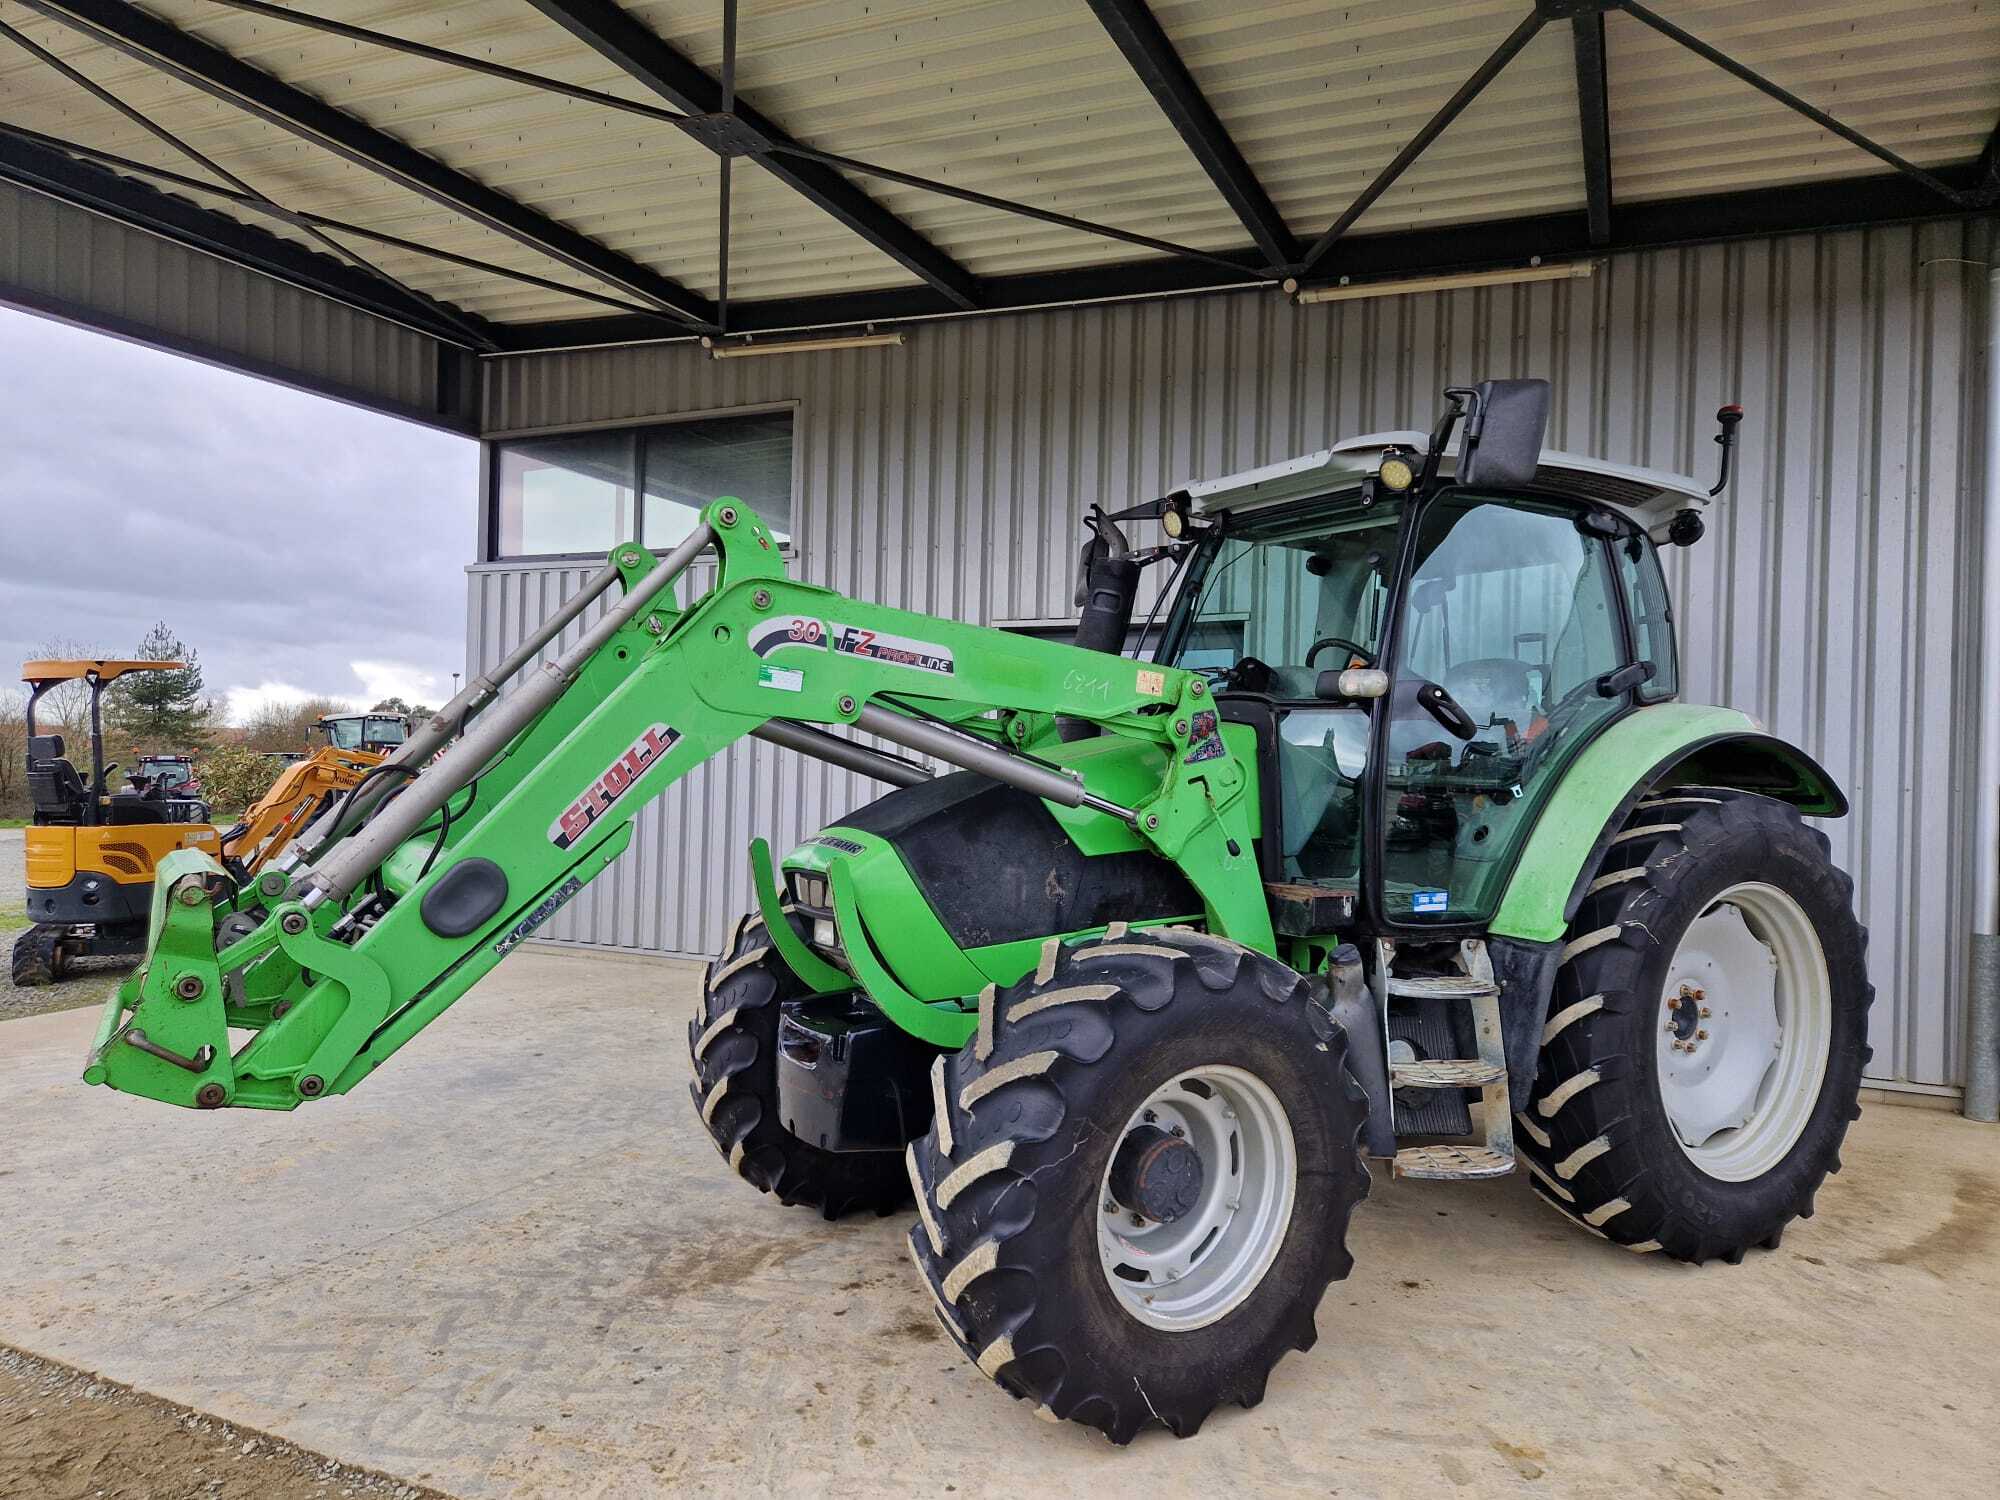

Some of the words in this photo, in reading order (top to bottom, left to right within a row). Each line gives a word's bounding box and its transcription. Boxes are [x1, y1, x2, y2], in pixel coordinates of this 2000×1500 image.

[788, 619, 820, 642] 30
[839, 627, 876, 656] FZ
[559, 727, 673, 842] STOLL
